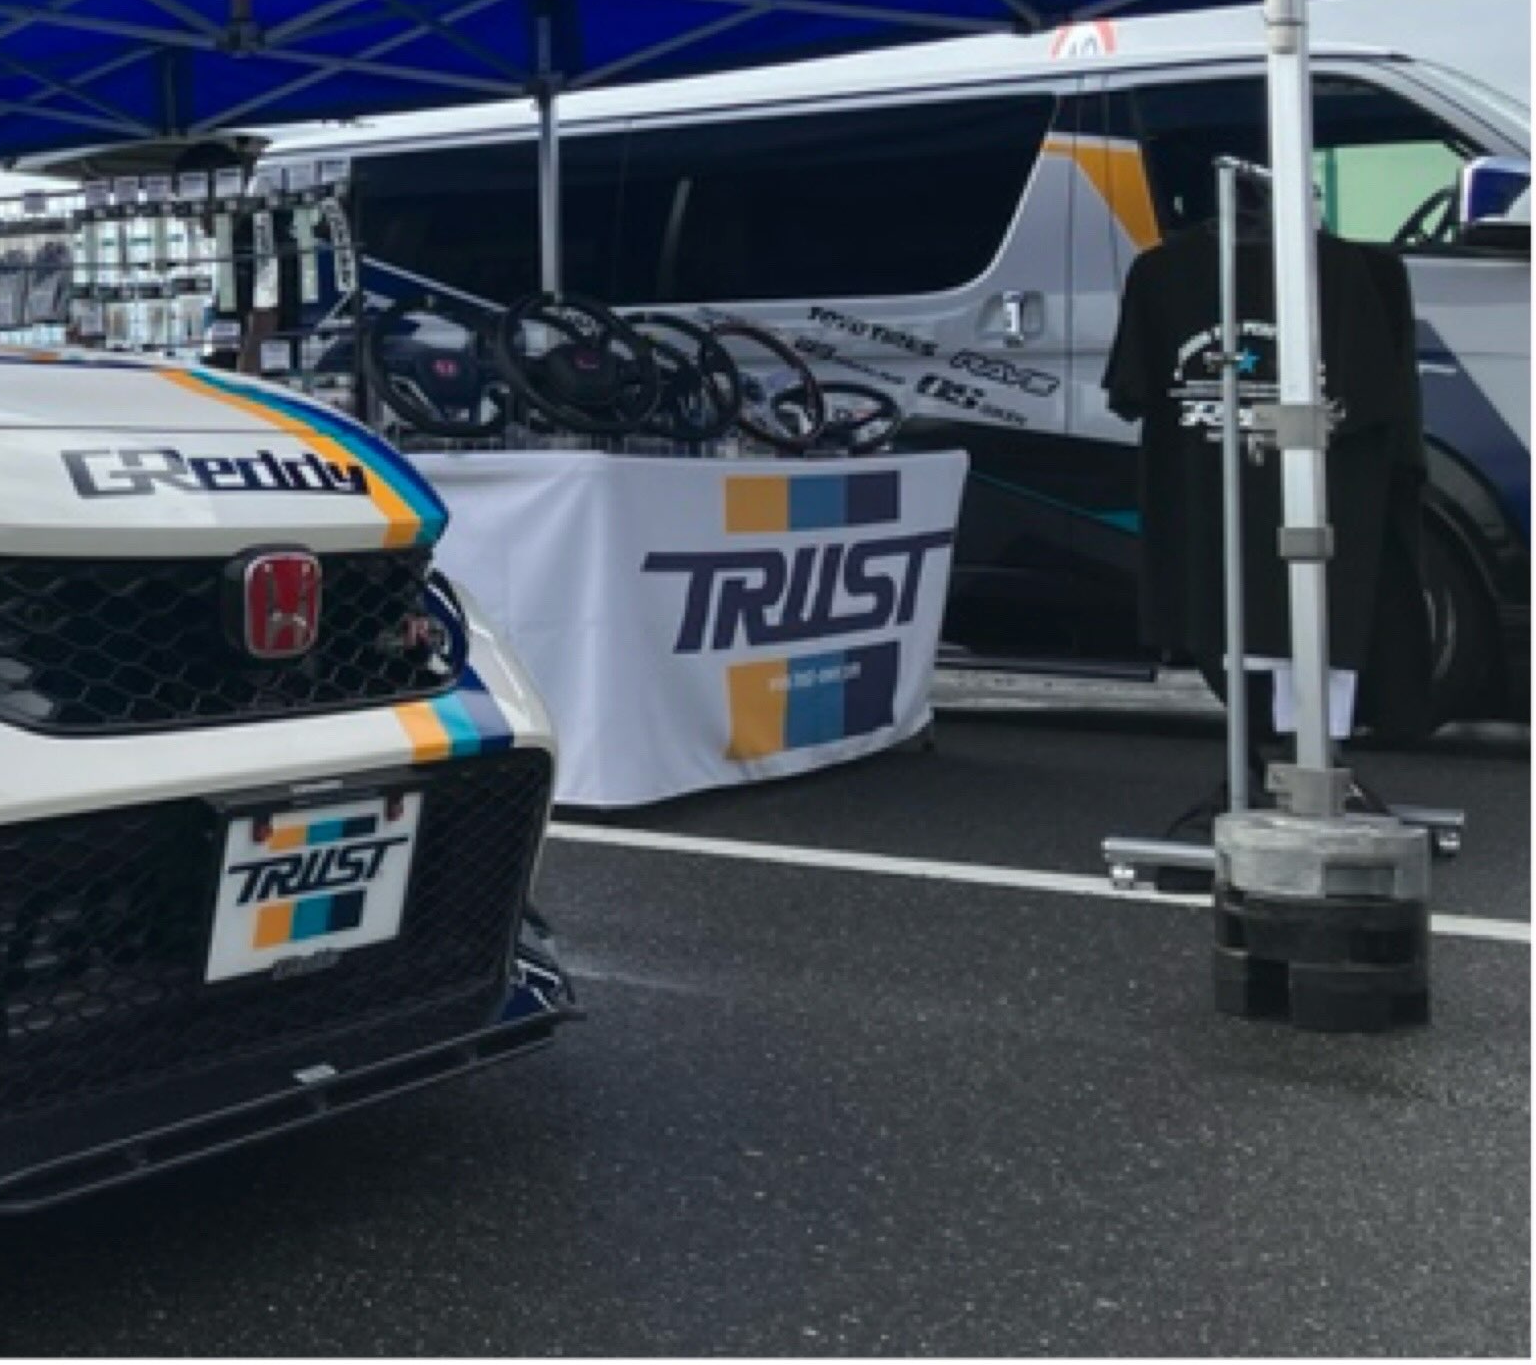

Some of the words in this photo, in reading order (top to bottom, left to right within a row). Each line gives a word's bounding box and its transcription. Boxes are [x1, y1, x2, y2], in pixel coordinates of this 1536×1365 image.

[61, 448, 372, 498] GReddy
[640, 530, 954, 655] TRUST
[227, 836, 409, 907] TRUST
